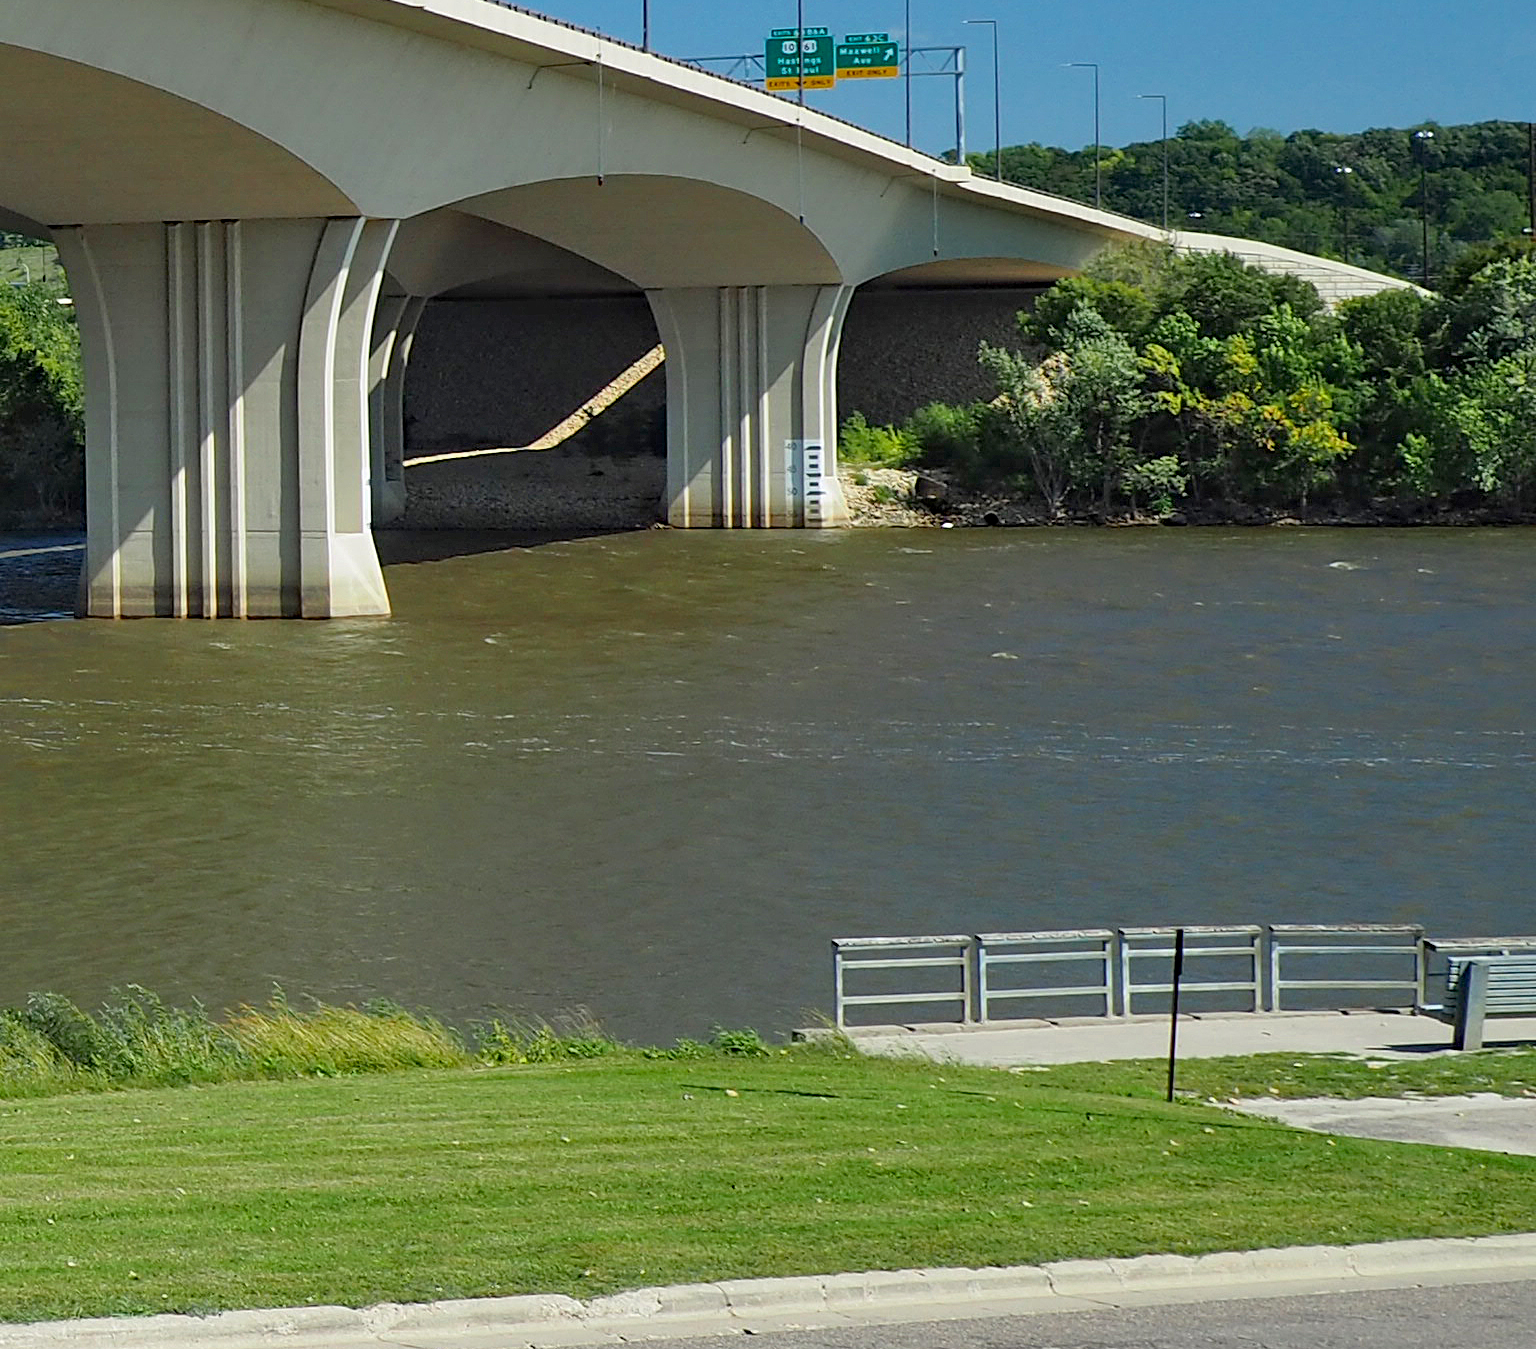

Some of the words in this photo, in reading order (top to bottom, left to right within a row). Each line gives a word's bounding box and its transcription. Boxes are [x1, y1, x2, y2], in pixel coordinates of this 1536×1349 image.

[784, 43, 795, 52] 10
[804, 42, 815, 51] 61
[839, 46, 880, 55] Maxwell
[777, 56, 822, 66] Hastngs
[781, 66, 792, 75] St
